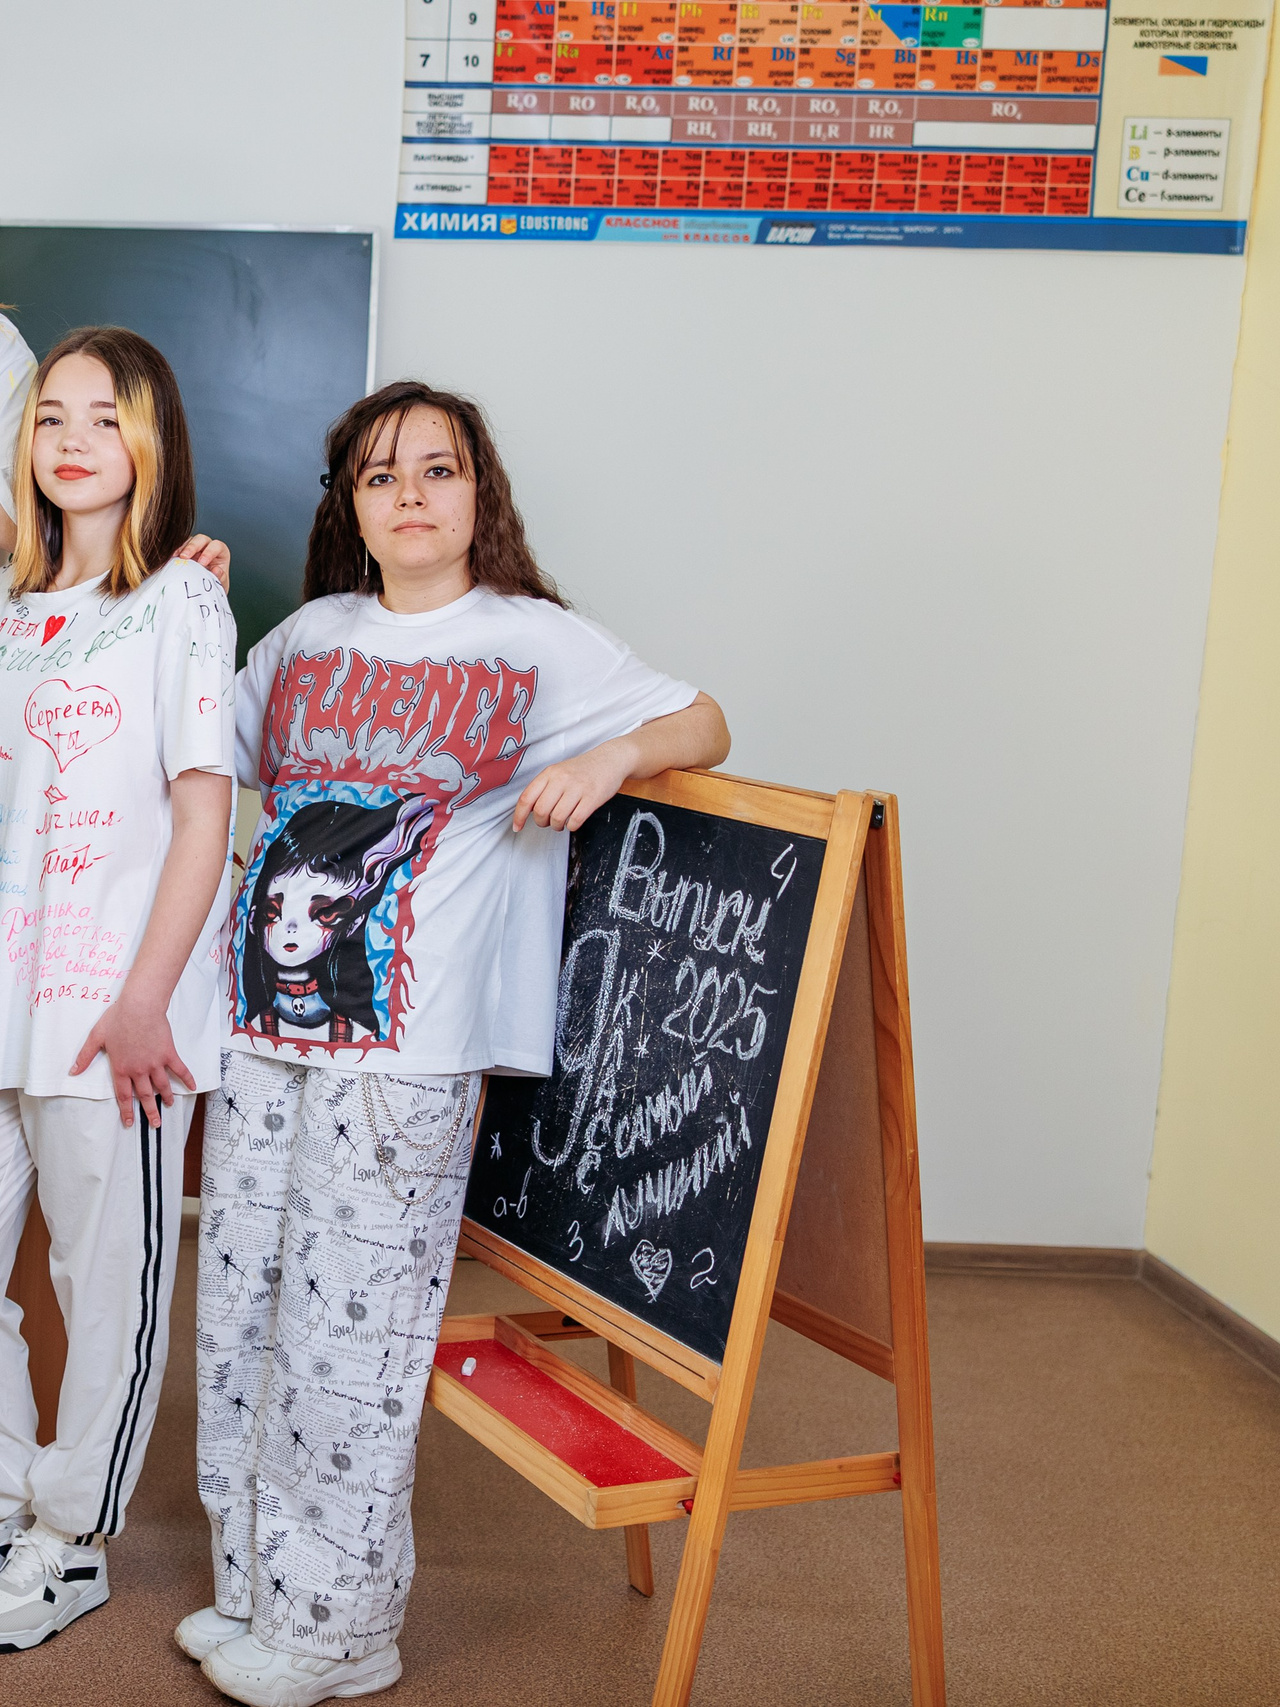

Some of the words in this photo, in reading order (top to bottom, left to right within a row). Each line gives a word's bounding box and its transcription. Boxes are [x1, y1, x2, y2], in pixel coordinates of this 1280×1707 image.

[531, 1, 554, 15] Au
[591, 1, 615, 19] Hg
[925, 7, 948, 22] Rn
[468, 12, 478, 25] 9
[496, 43, 515, 57] Fr
[557, 44, 579, 58] Ra
[652, 46, 673, 60] Ac
[712, 46, 734, 61] Rf
[772, 47, 795, 62] Db
[835, 49, 855, 66] Sg
[894, 50, 916, 63] Bh
[955, 51, 977, 64] Hs
[420, 54, 430, 67] 7
[464, 55, 479, 67] 10
[1014, 52, 1038, 66] Mt
[1076, 52, 1099, 67] Ds
[570, 96, 595, 111] RO
[869, 126, 894, 139] HR
[1130, 124, 1148, 140] Li
[1126, 166, 1150, 181] Cu
[1125, 187, 1146, 203] Ce
[402, 212, 497, 231] ХИМИЯ
[520, 215, 588, 231] EDUSTRONG
[606, 217, 679, 228] КЛАССНОЕ
[684, 234, 750, 243] КЛАССОВ
[609, 808, 772, 965] Выпуск
[662, 955, 778, 1062] 2025
[384, 1073, 394, 1083] The
[353, 1163, 381, 1182] Love
[341, 1229, 352, 1239] The
[690, 1246, 718, 1291] 2
[328, 1320, 354, 1338] Love
[320, 1386, 330, 1395] The
[316, 1467, 341, 1485] Love
[312, 1528, 321, 1537] The
[292, 1619, 317, 1638] Love
